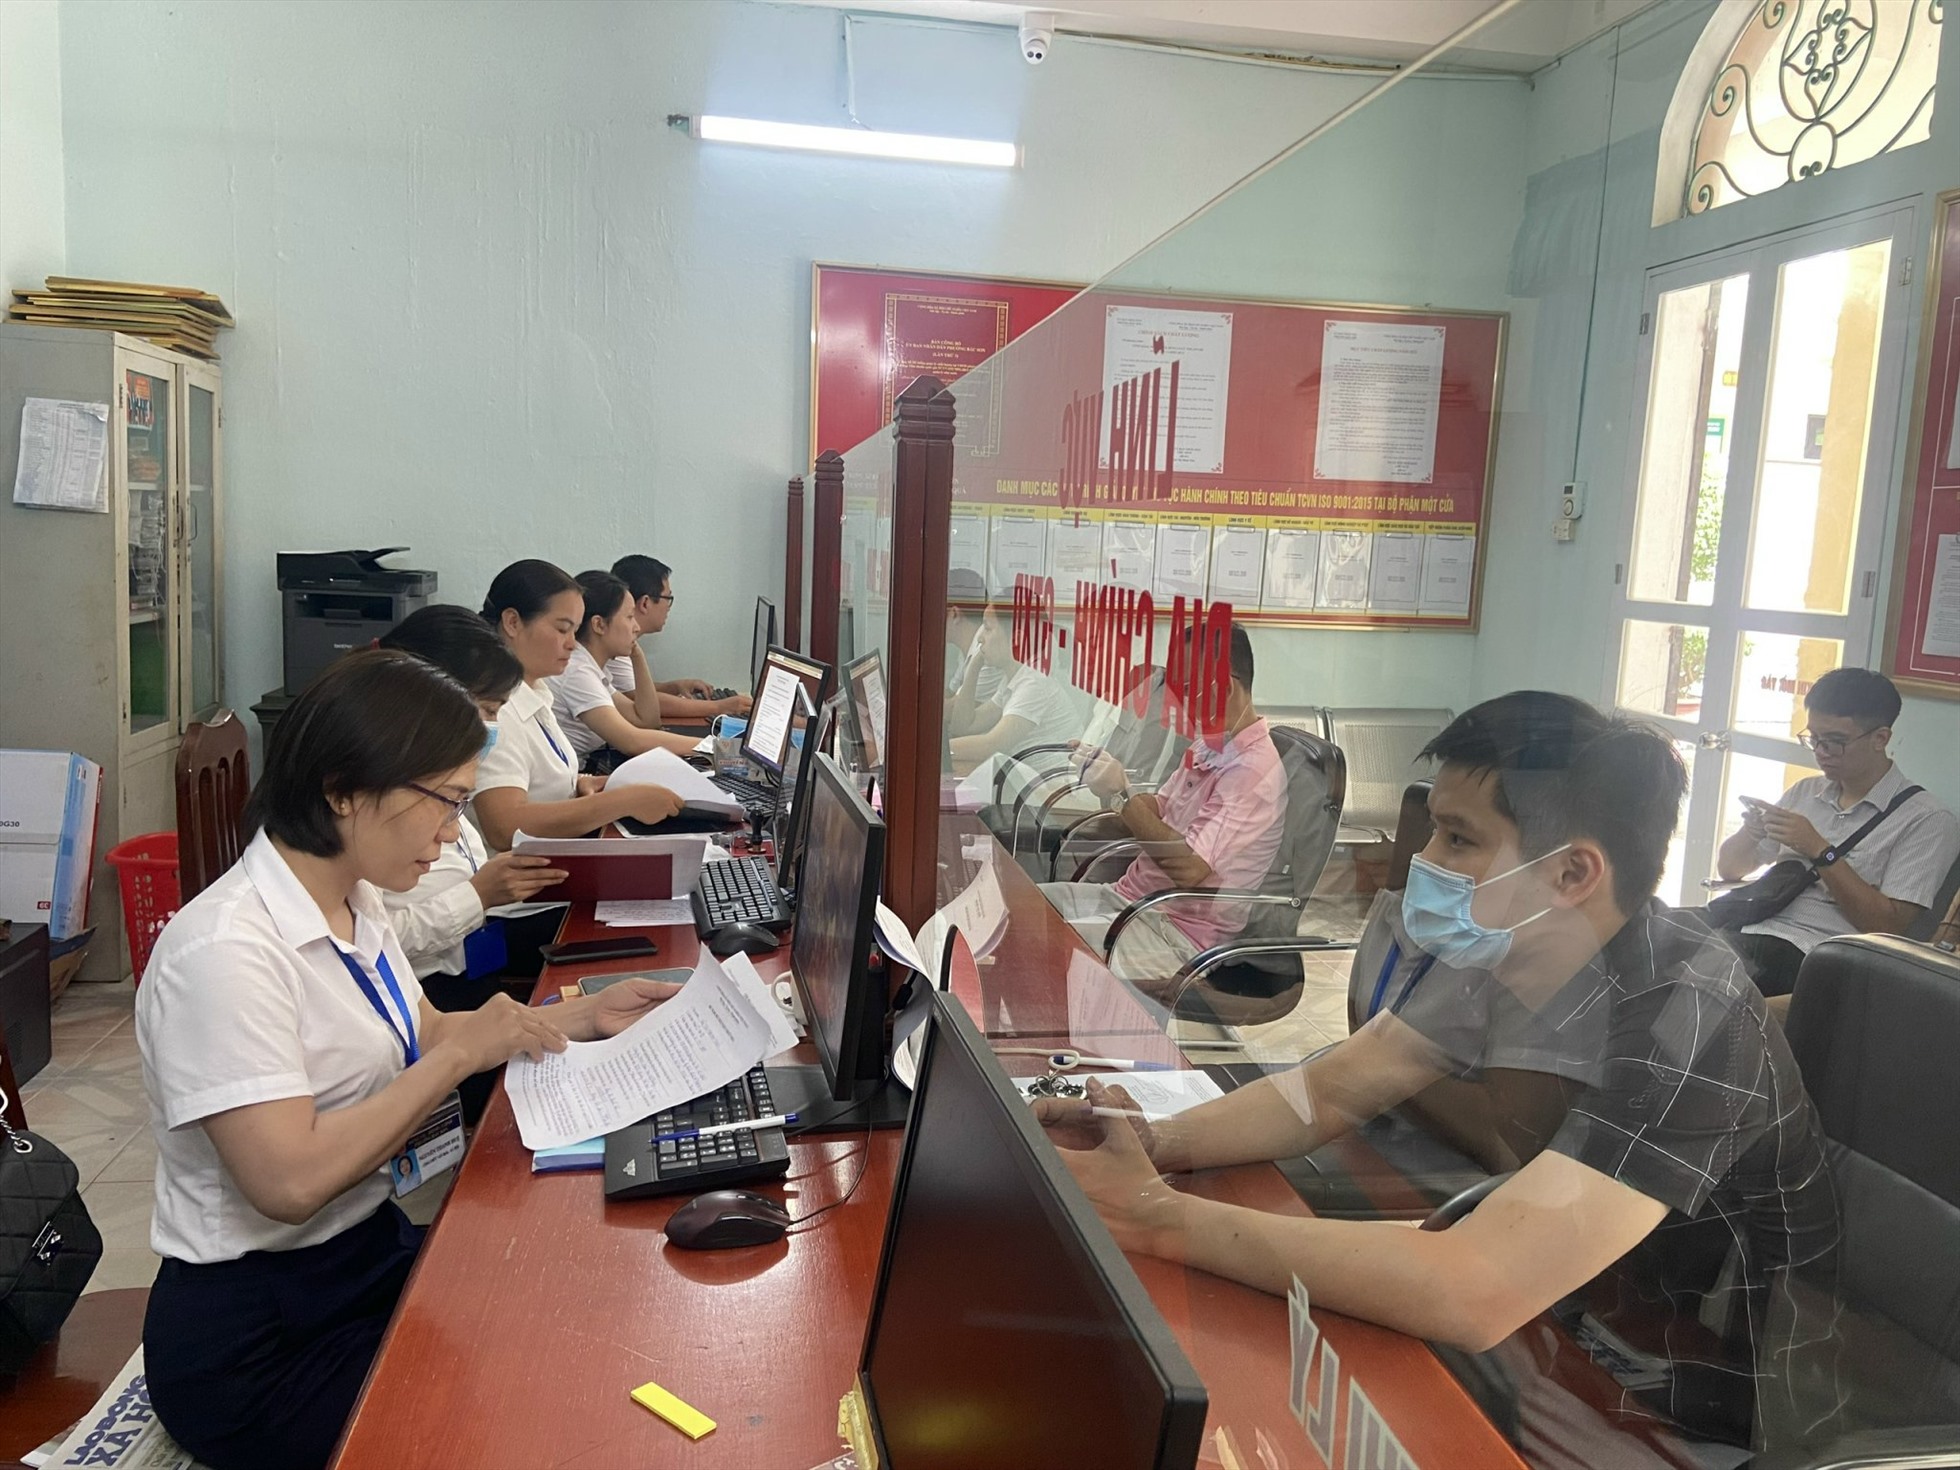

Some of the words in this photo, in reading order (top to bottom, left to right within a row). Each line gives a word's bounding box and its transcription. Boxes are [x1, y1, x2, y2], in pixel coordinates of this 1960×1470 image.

[997, 480, 1019, 494] DANH
[1020, 481, 1040, 498] MỤC
[1041, 480, 1058, 497] CÁC
[1180, 486, 1203, 504] HÀNH
[1204, 487, 1228, 505] CHÍNH
[1230, 490, 1249, 505] THEO
[1251, 488, 1268, 506] TIÊU
[1269, 487, 1295, 508] CHUẨN
[1297, 493, 1318, 509] TCVN
[1318, 494, 1332, 509] ISO
[1333, 494, 1372, 510] 9001:2015
[1373, 496, 1386, 513] TẠI
[1387, 495, 1398, 514] BỘ
[1399, 495, 1420, 513] PHẬN
[1421, 496, 1438, 514] MỘT
